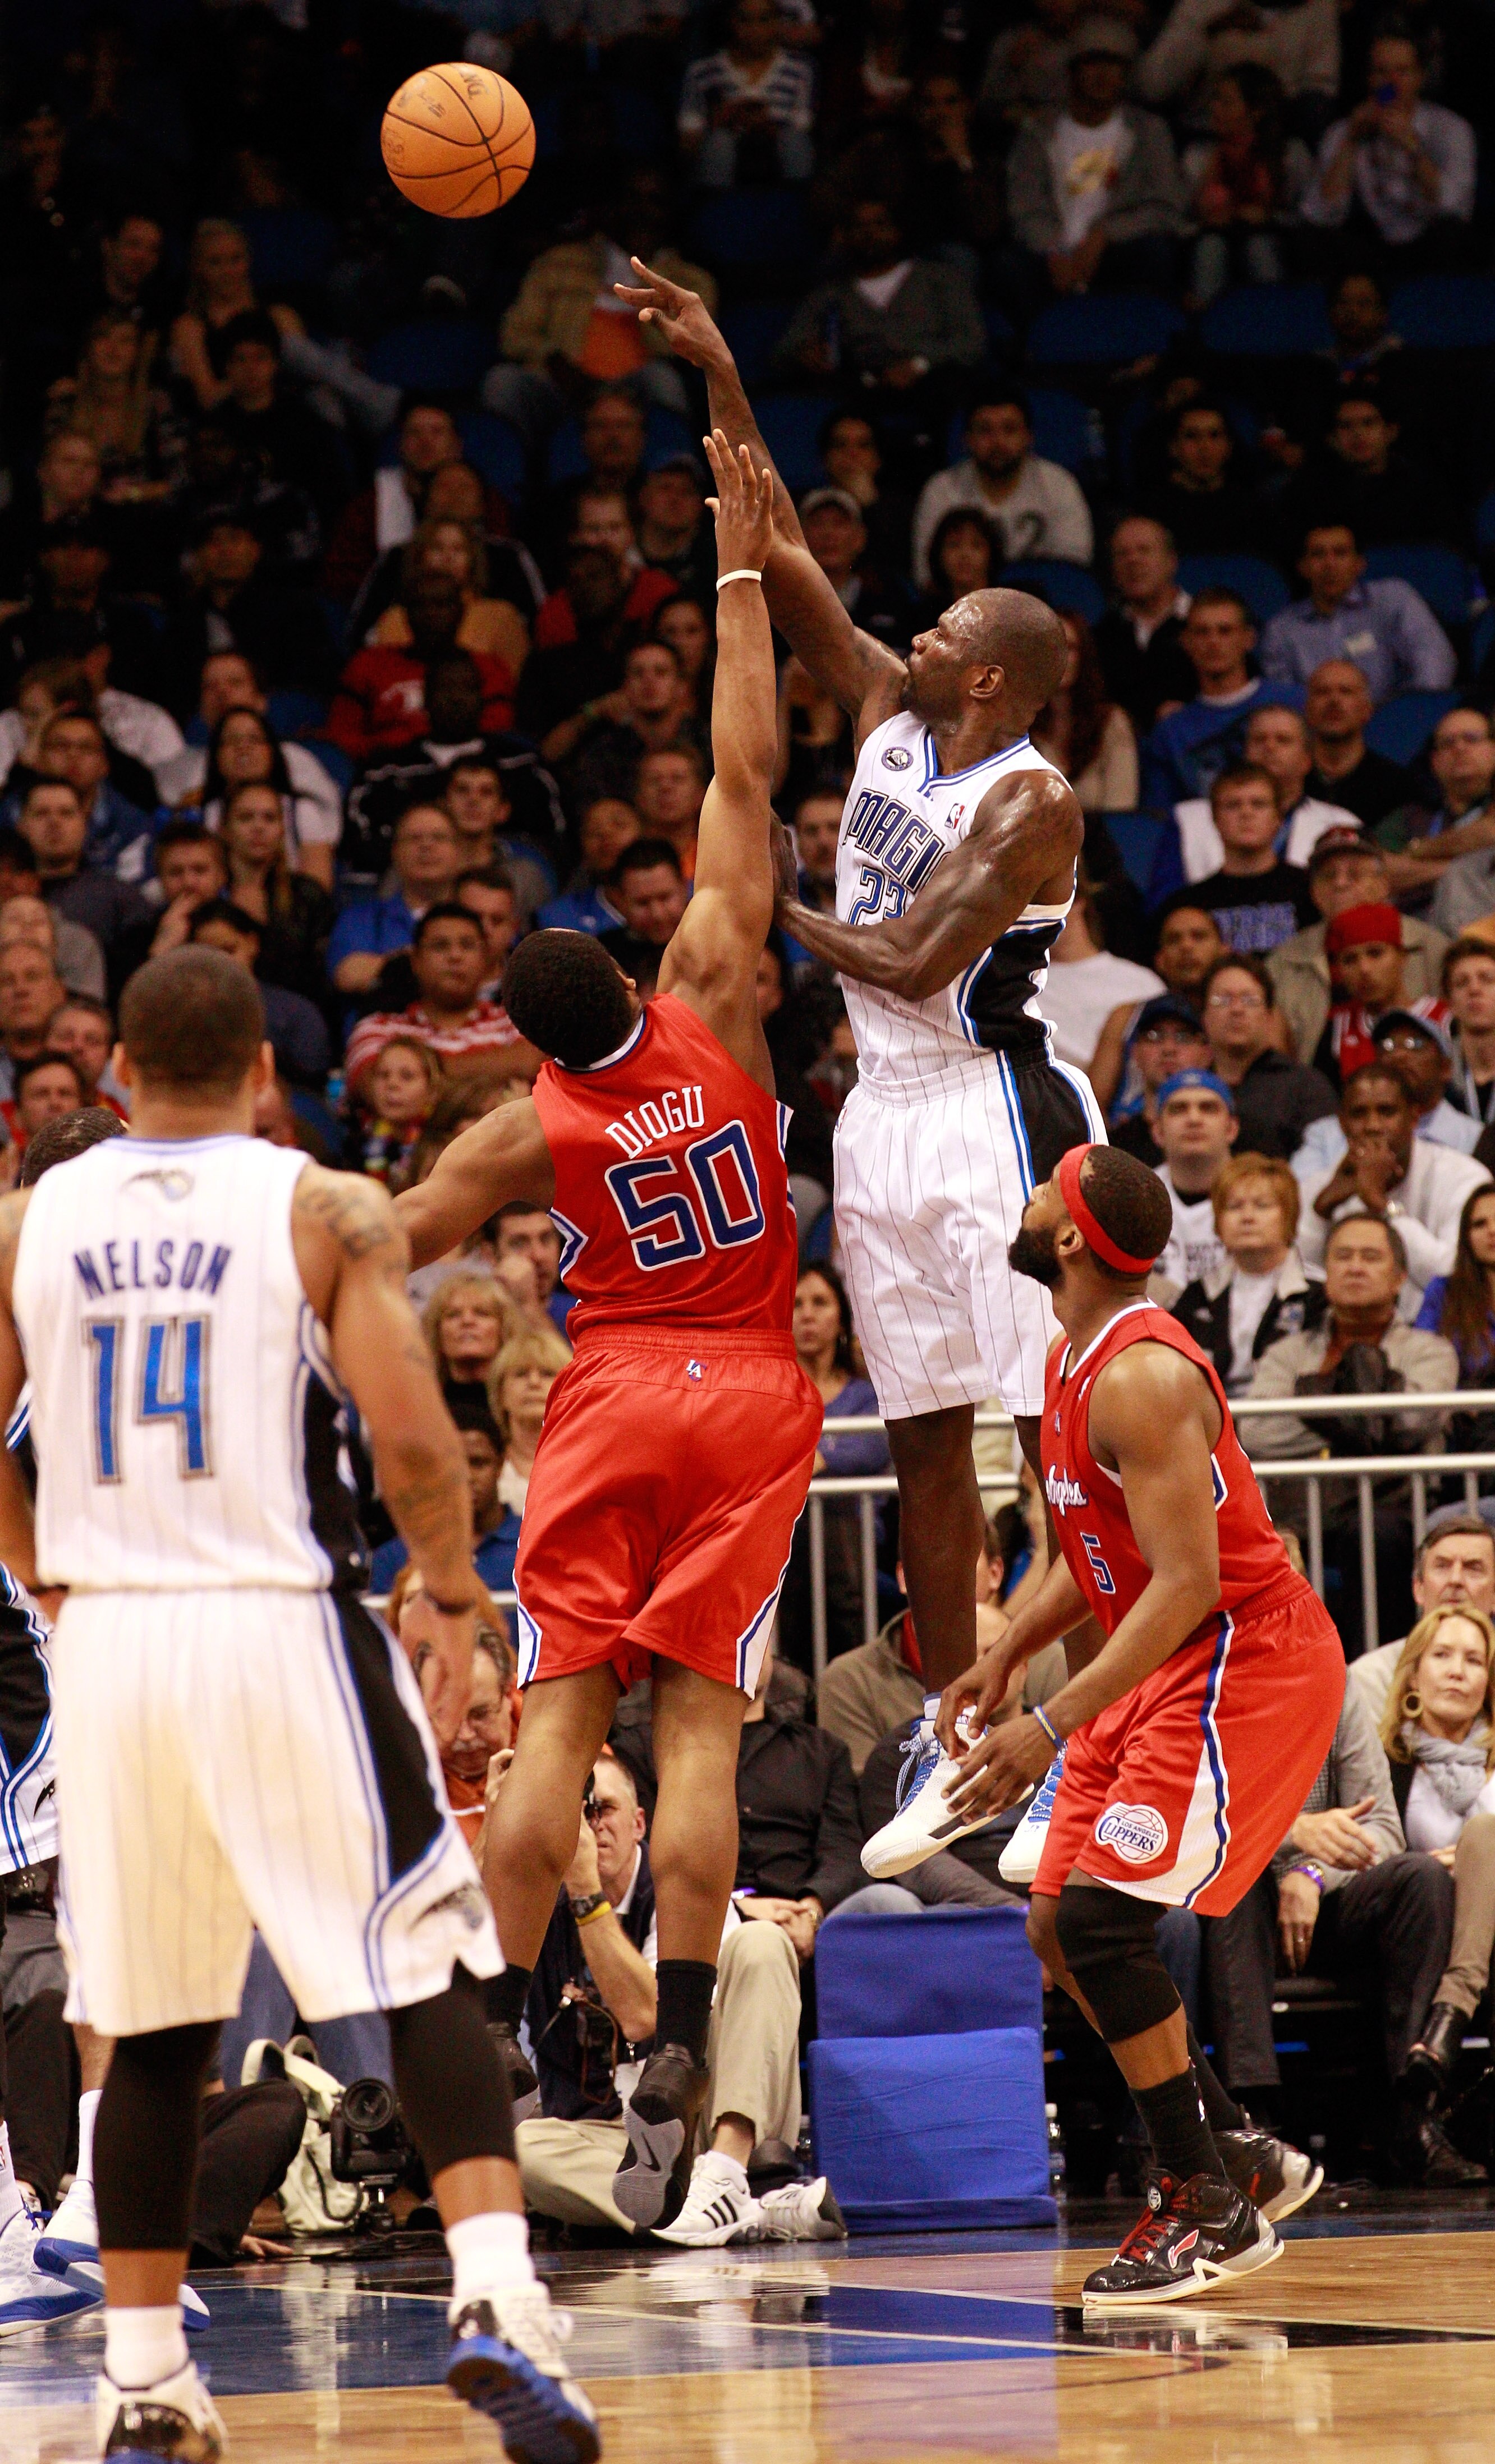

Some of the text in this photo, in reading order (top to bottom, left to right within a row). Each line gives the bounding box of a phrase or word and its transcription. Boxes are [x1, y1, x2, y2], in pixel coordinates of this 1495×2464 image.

[845, 788, 951, 895] MAGI
[604, 1086, 704, 1160] DIOGU
[604, 1119, 765, 1271] 50
[74, 1240, 232, 1300] NELSON
[81, 1311, 214, 1486] 14
[1080, 1532, 1116, 1594] 5
[1098, 1815, 1157, 1851] CLIPPERS
[1121, 1820, 1159, 1840] LOS ANGELES
